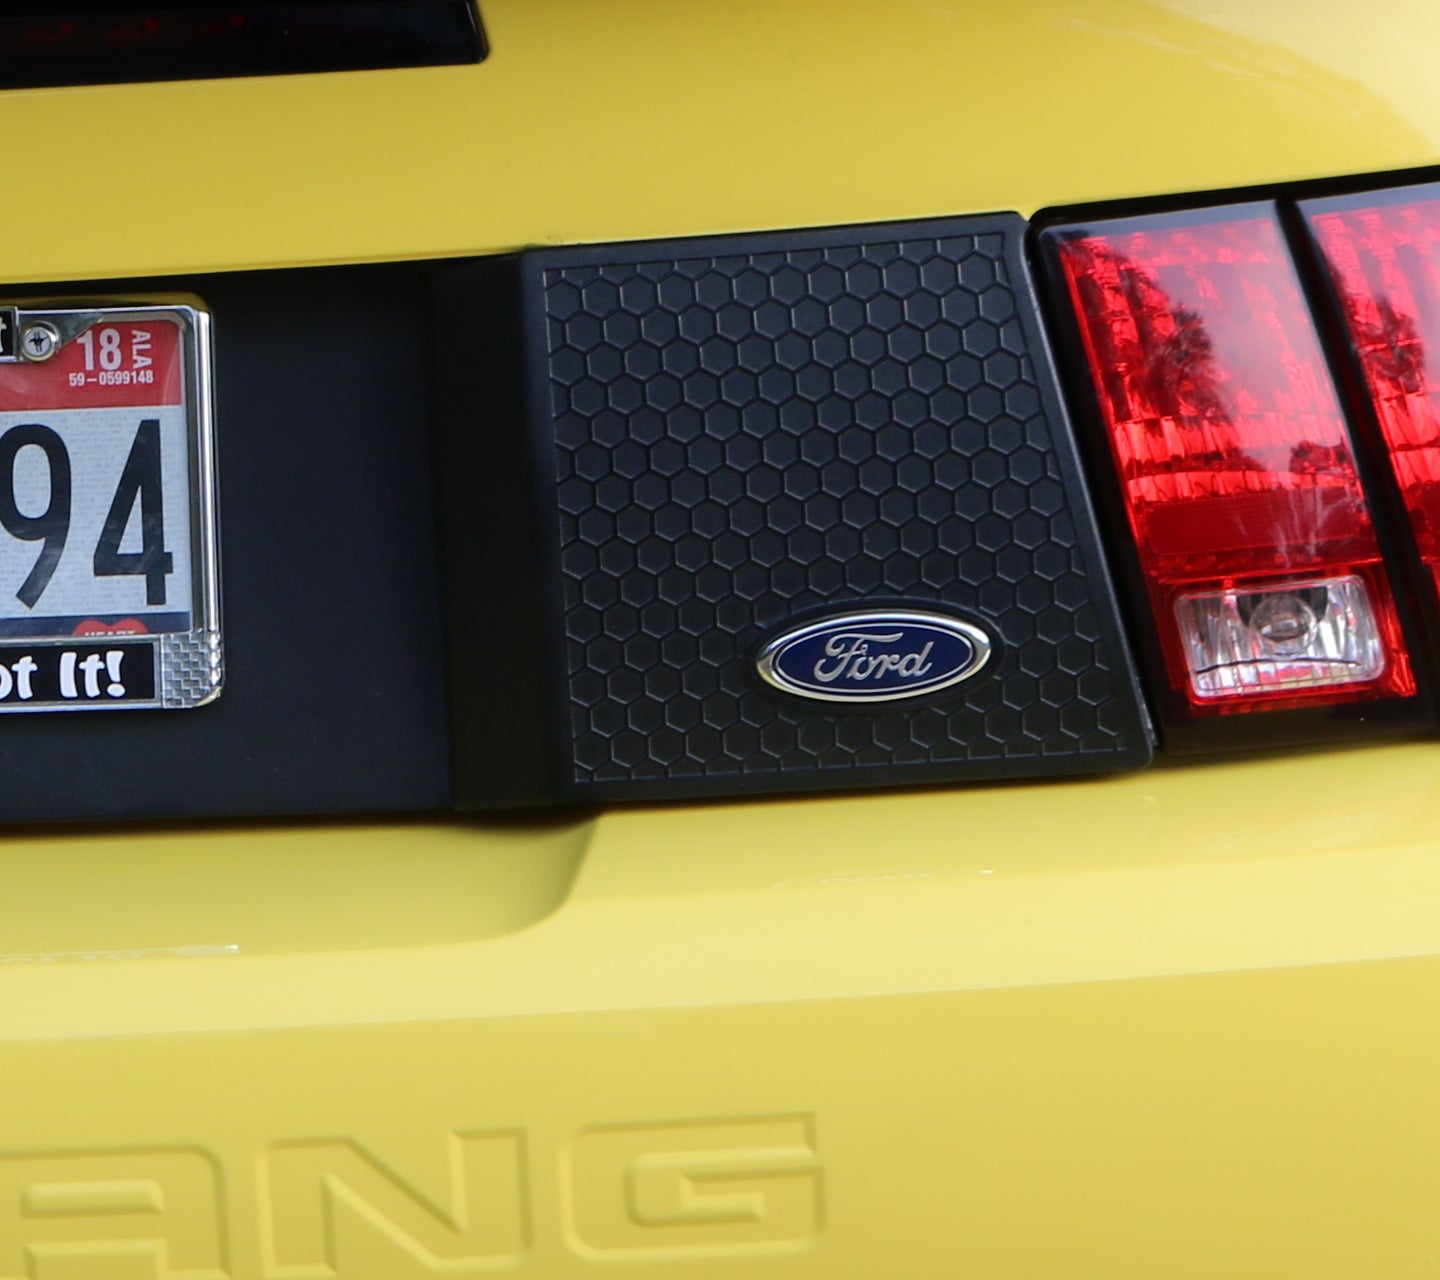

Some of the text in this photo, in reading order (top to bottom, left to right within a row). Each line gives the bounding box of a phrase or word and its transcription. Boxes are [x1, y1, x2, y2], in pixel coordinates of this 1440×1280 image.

[76, 328, 122, 370] 18
[132, 330, 152, 369] ALA
[59, 651, 126, 699] It!
[814, 631, 934, 683] Ford
